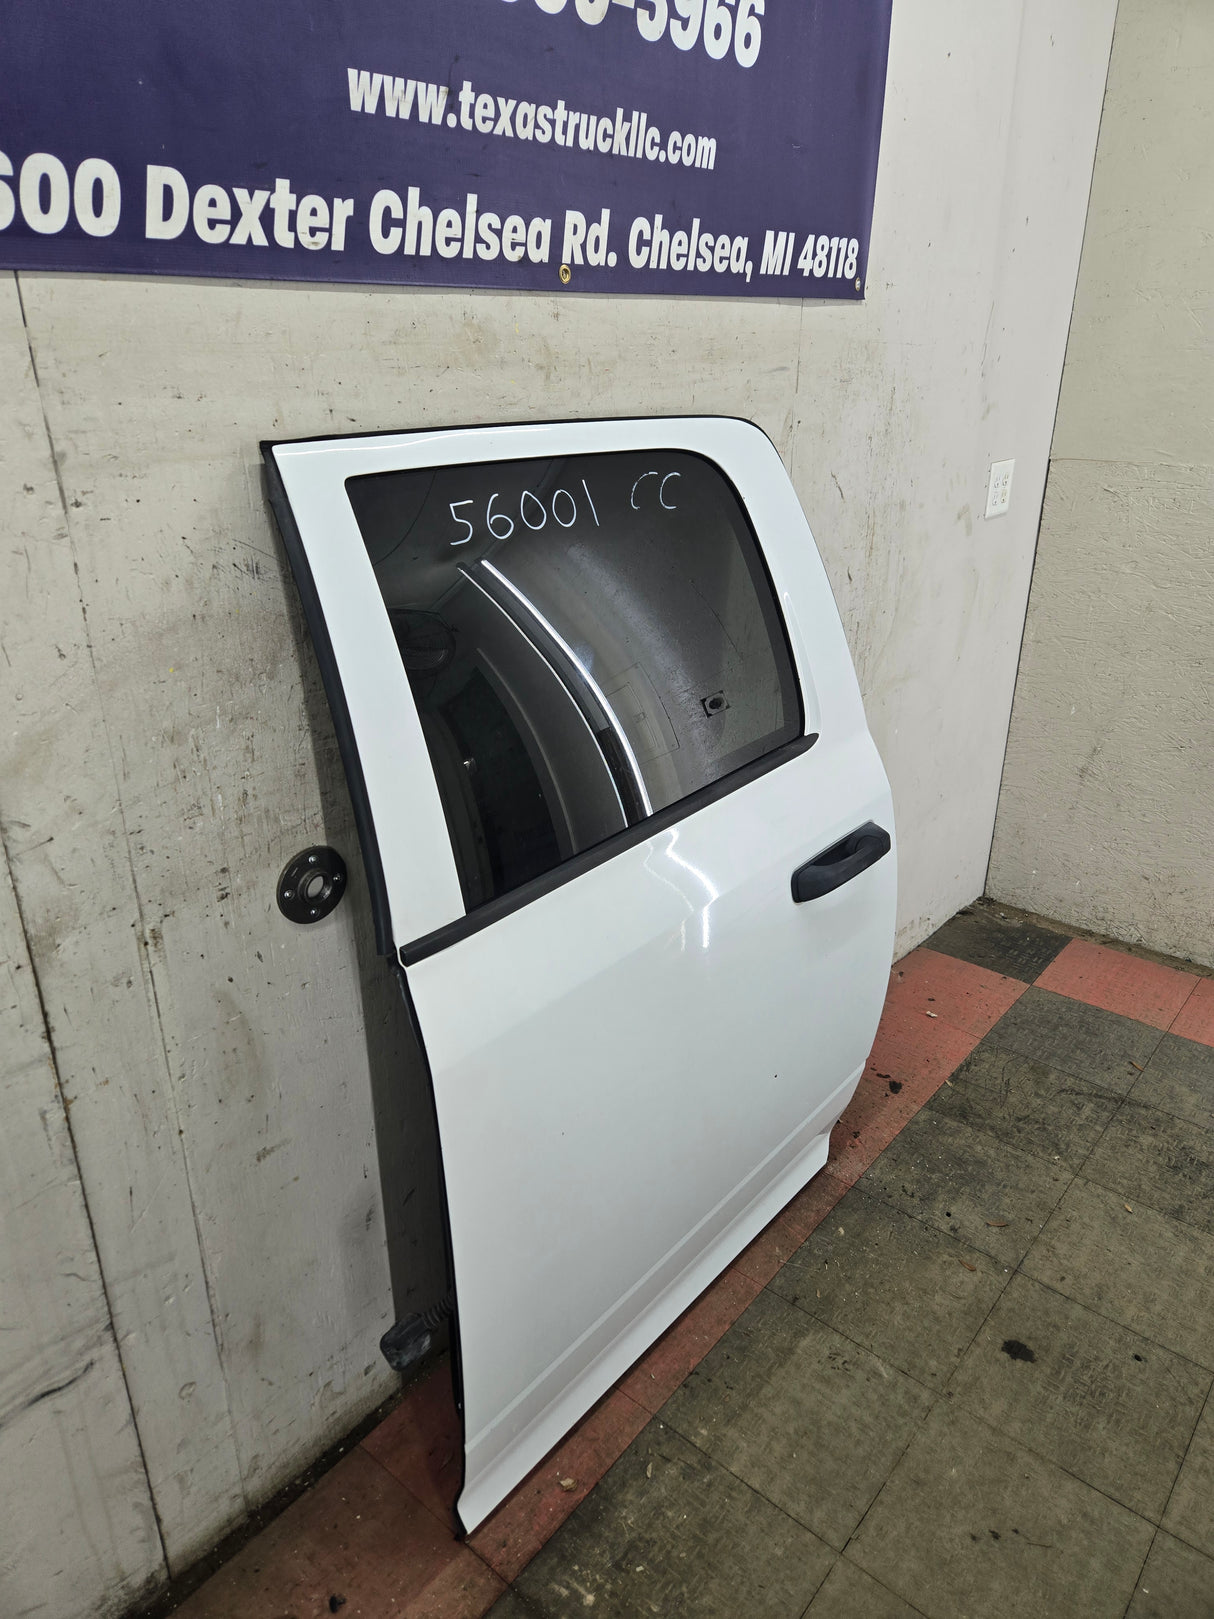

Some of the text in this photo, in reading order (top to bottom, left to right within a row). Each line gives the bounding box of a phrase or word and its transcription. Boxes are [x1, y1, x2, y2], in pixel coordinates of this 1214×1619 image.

[503, 0, 766, 68] -966
[347, 67, 718, 170] www.texastruckllc.com
[145, 164, 354, 251] Dexter
[369, 186, 552, 264] Chelsea
[561, 208, 618, 268] Rd.
[628, 214, 753, 283] Chelsea,
[760, 229, 796, 276] MI
[797, 234, 860, 280] 48118
[449, 478, 600, 546] 56001
